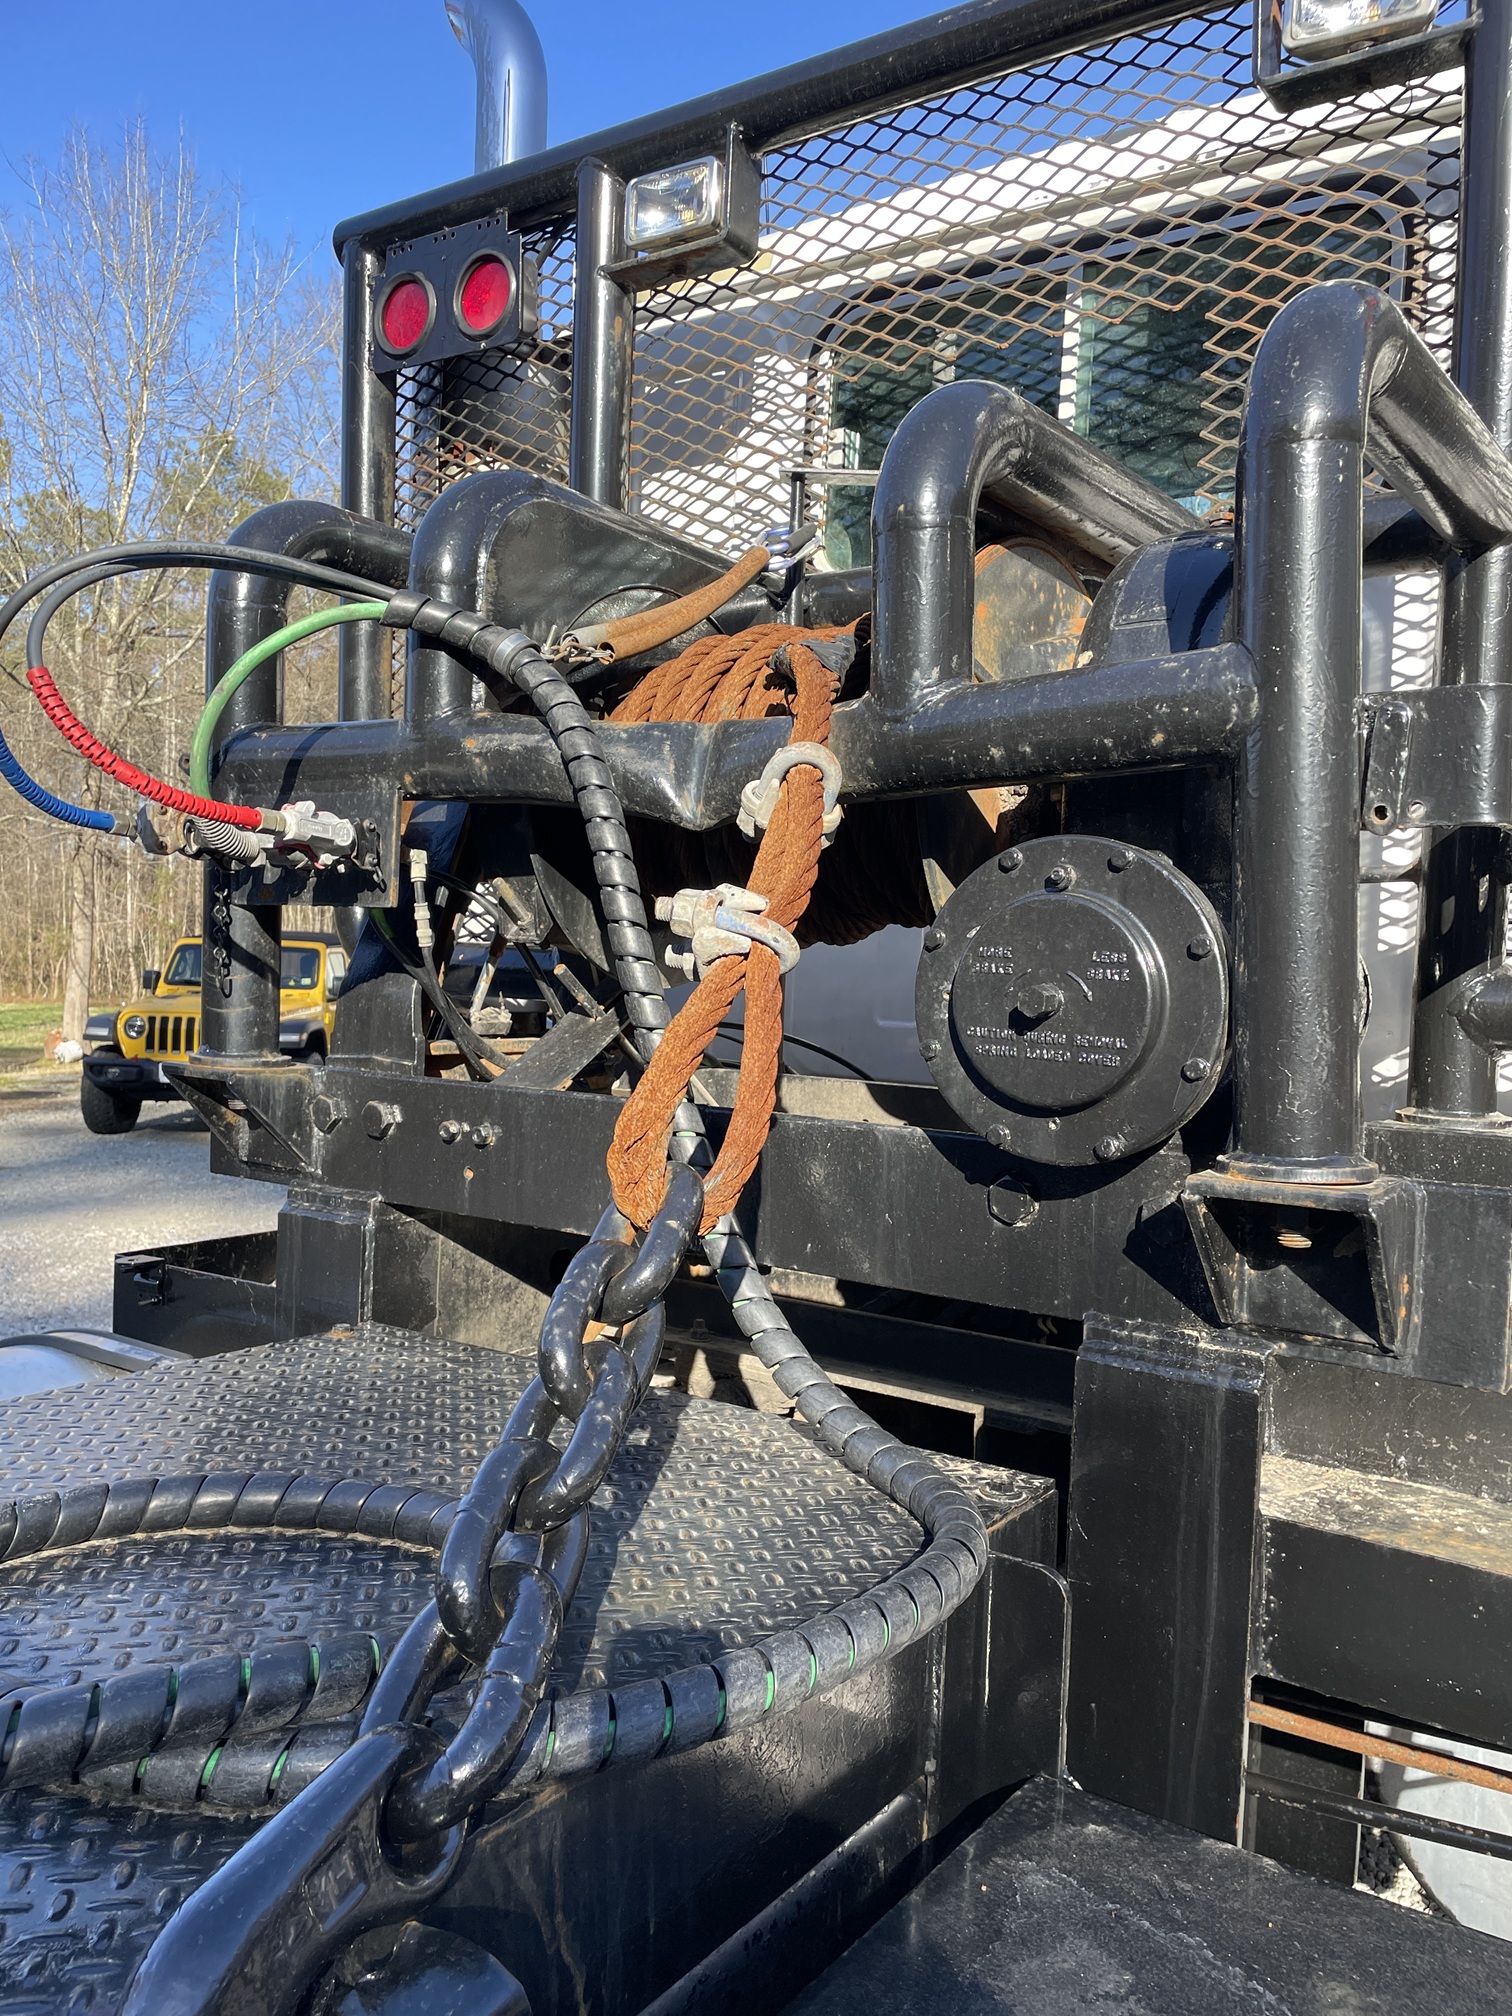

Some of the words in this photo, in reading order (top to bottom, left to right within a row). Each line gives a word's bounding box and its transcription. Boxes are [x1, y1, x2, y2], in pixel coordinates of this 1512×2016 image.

[978, 946, 1013, 958] MORE
[1092, 950, 1127, 964] LESS
[972, 962, 1014, 975] BRAKE
[1086, 967, 1130, 982] BRAKE
[967, 1027, 1017, 1041] CAUTION
[1023, 1031, 1066, 1044] DURING
[1073, 1034, 1127, 1049] REMOVAL
[975, 1044, 1017, 1057] SPRING
[1026, 1048, 1070, 1063] LOADED
[1078, 1052, 1121, 1067] COVER
